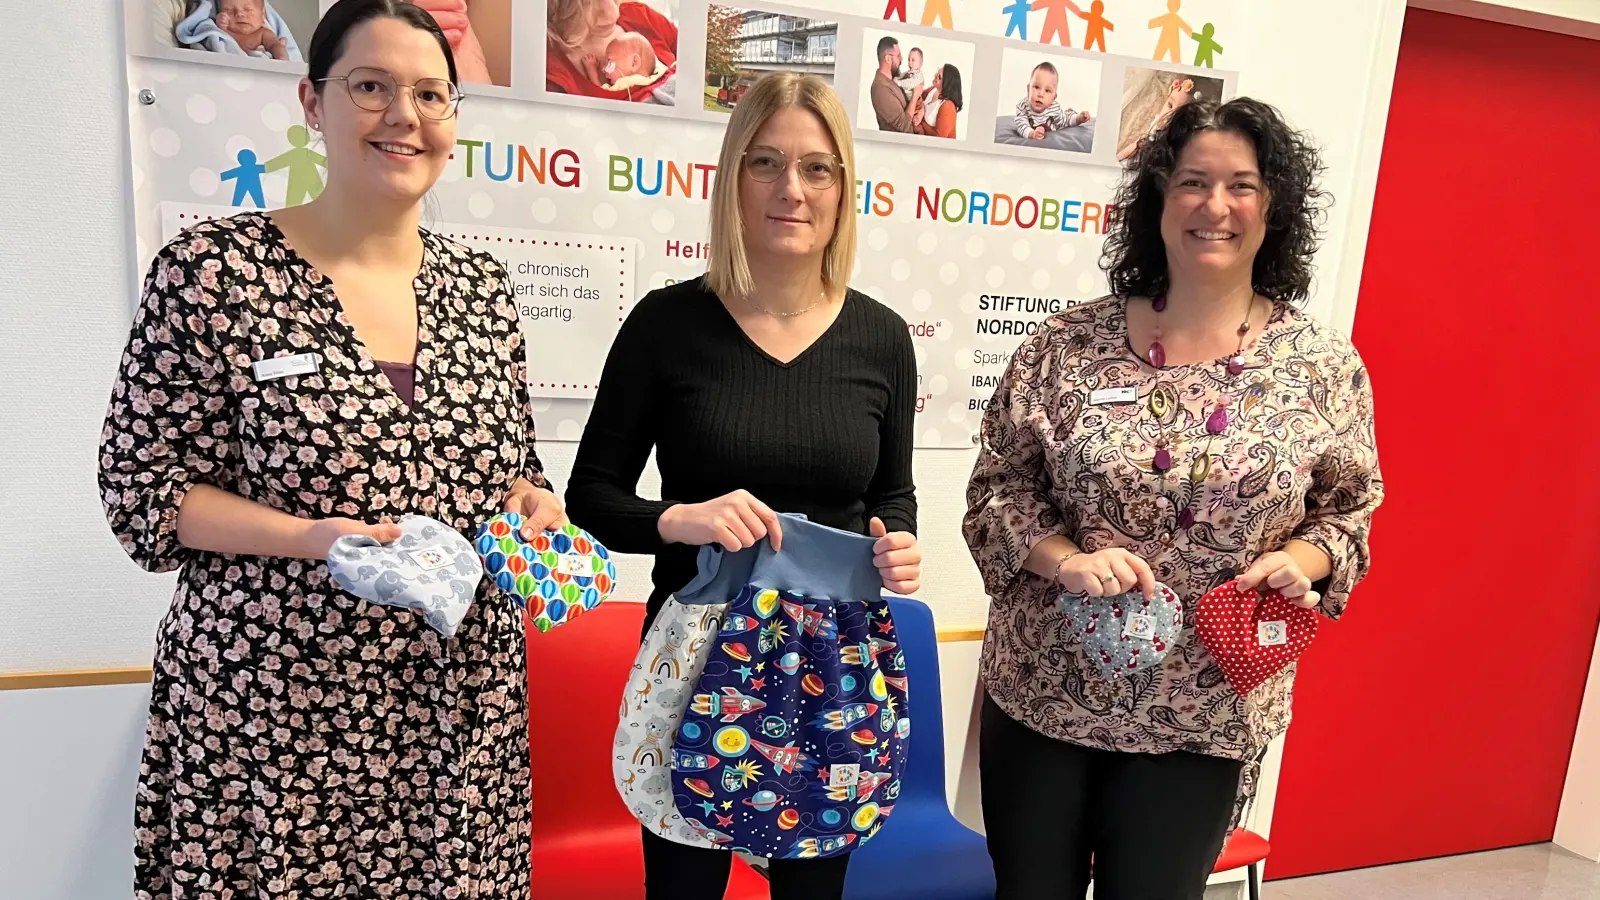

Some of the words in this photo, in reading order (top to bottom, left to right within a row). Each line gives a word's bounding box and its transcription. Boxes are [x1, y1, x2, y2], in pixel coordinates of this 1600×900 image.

[448, 139, 580, 188] TUNG
[517, 261, 589, 278] chronisch
[539, 283, 569, 298] sich
[573, 285, 600, 300] das
[979, 294, 1061, 314] STIFTUNG
[971, 375, 1002, 388] IBAN
